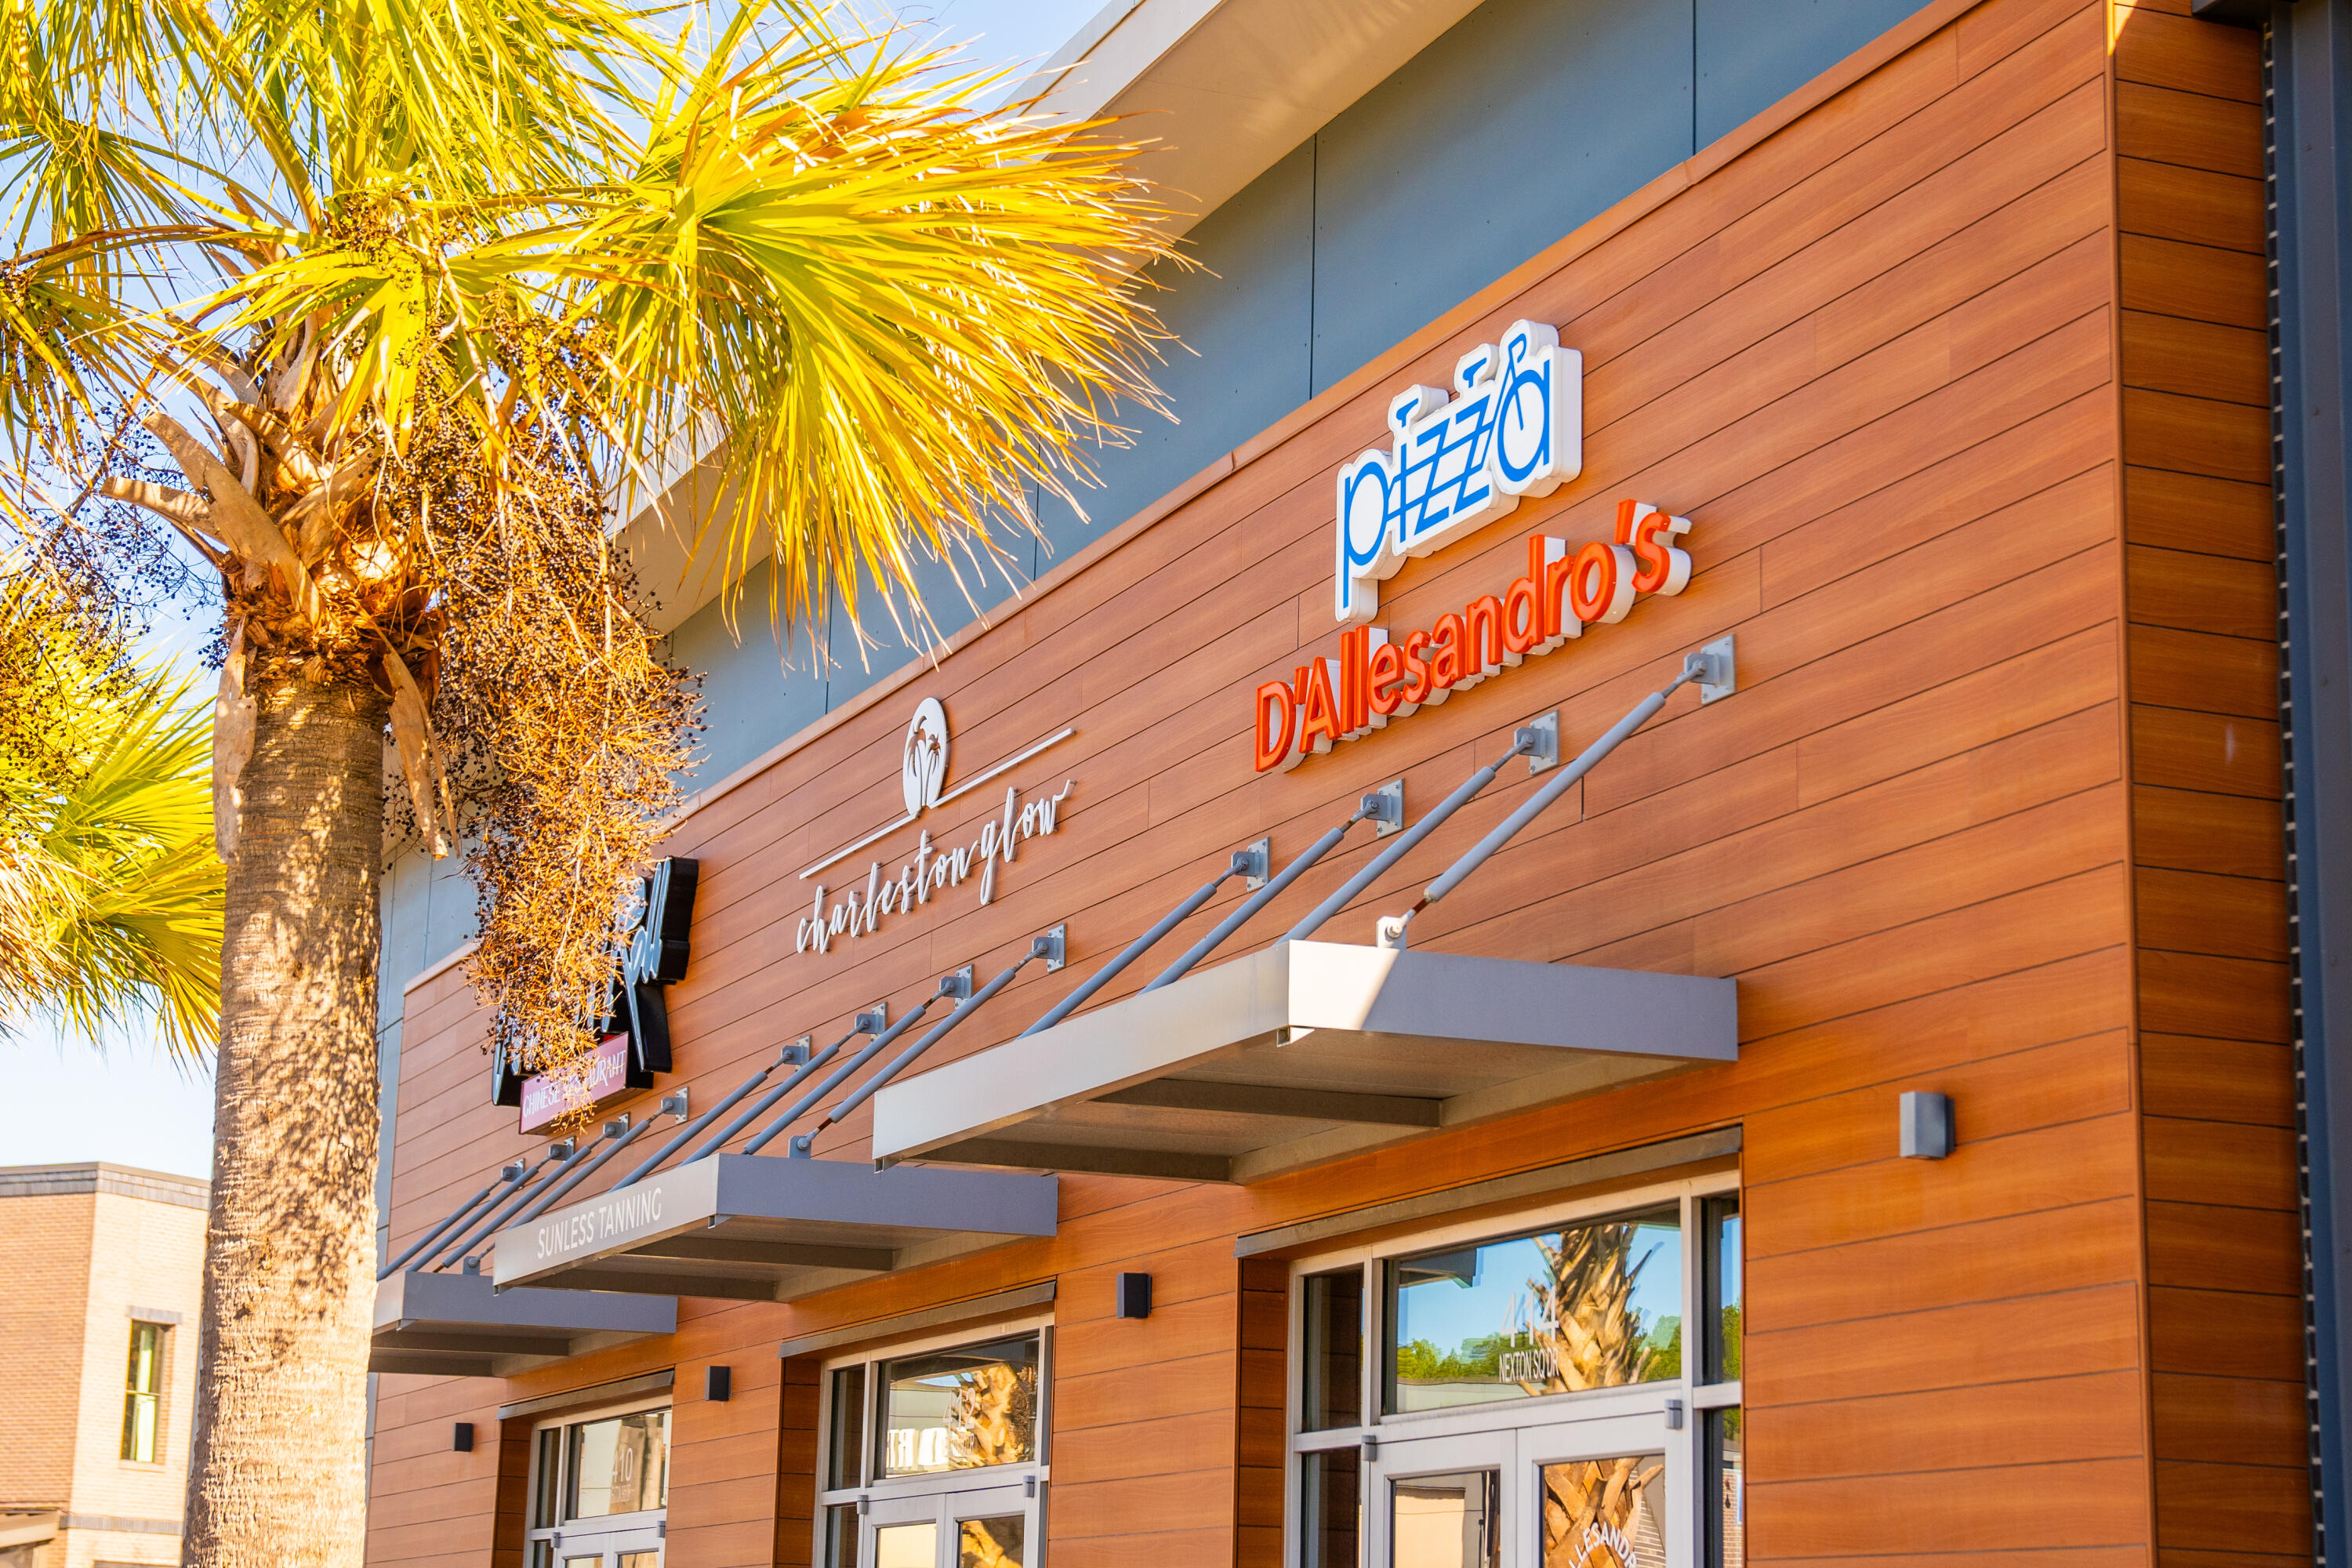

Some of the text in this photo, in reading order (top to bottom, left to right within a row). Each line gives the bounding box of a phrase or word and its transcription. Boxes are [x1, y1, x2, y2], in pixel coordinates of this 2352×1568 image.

[1343, 333, 1551, 608] pizza
[1254, 499, 1672, 773] D'Allesandro's
[797, 779, 1073, 955] charleston glow
[523, 1082, 561, 1118] CHINESE
[537, 1187, 662, 1260] SUNLESS TANNING
[1500, 1286, 1560, 1348] 414
[1499, 1346, 1560, 1383] NEXTON SQ DR
